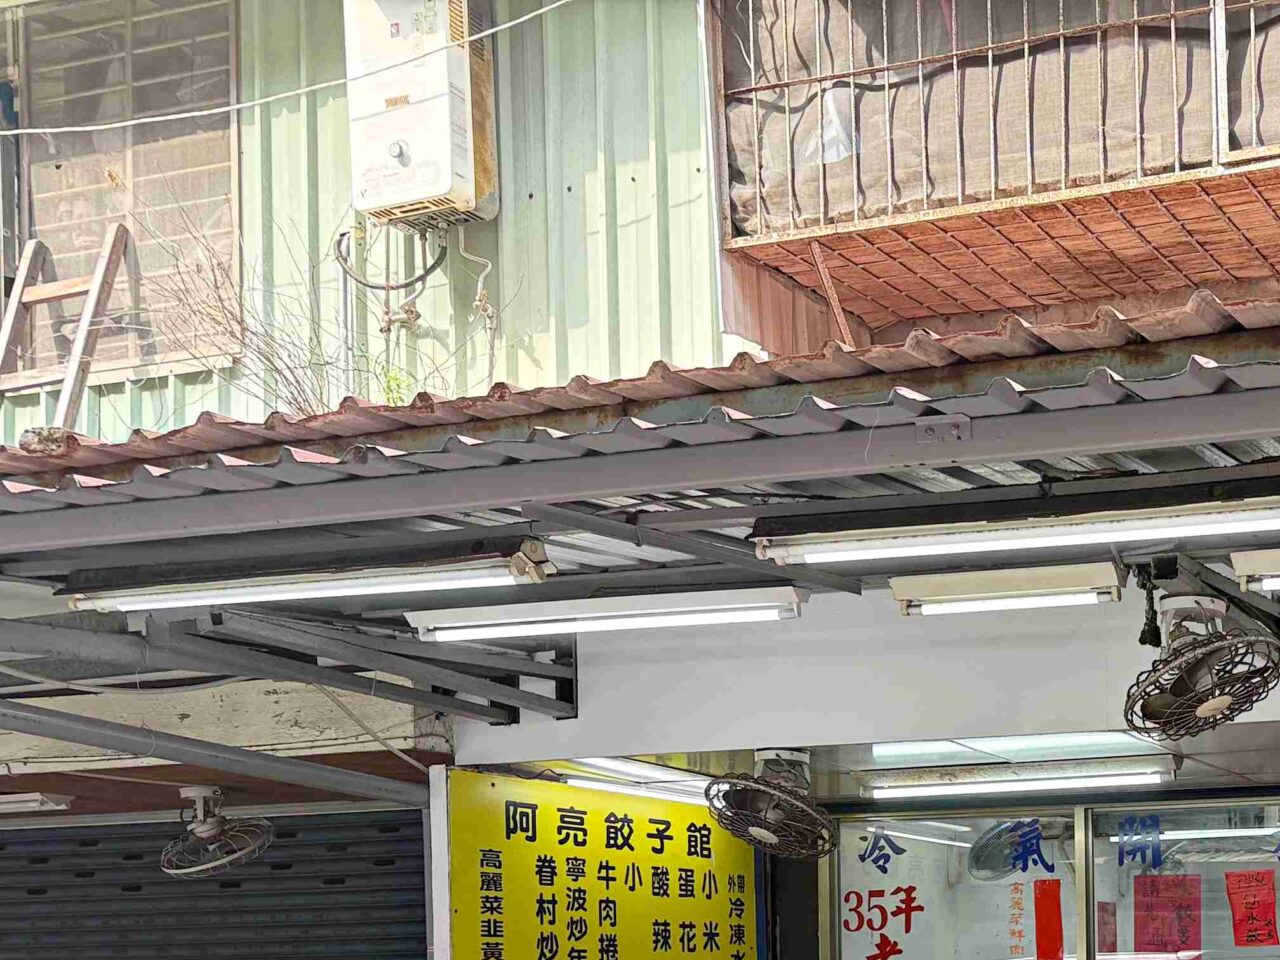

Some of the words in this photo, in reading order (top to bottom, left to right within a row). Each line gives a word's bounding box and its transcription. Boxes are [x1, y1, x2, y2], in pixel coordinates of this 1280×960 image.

[504, 800, 712, 858] 阿亮餃子館
[843, 886, 924, 934] 35年
